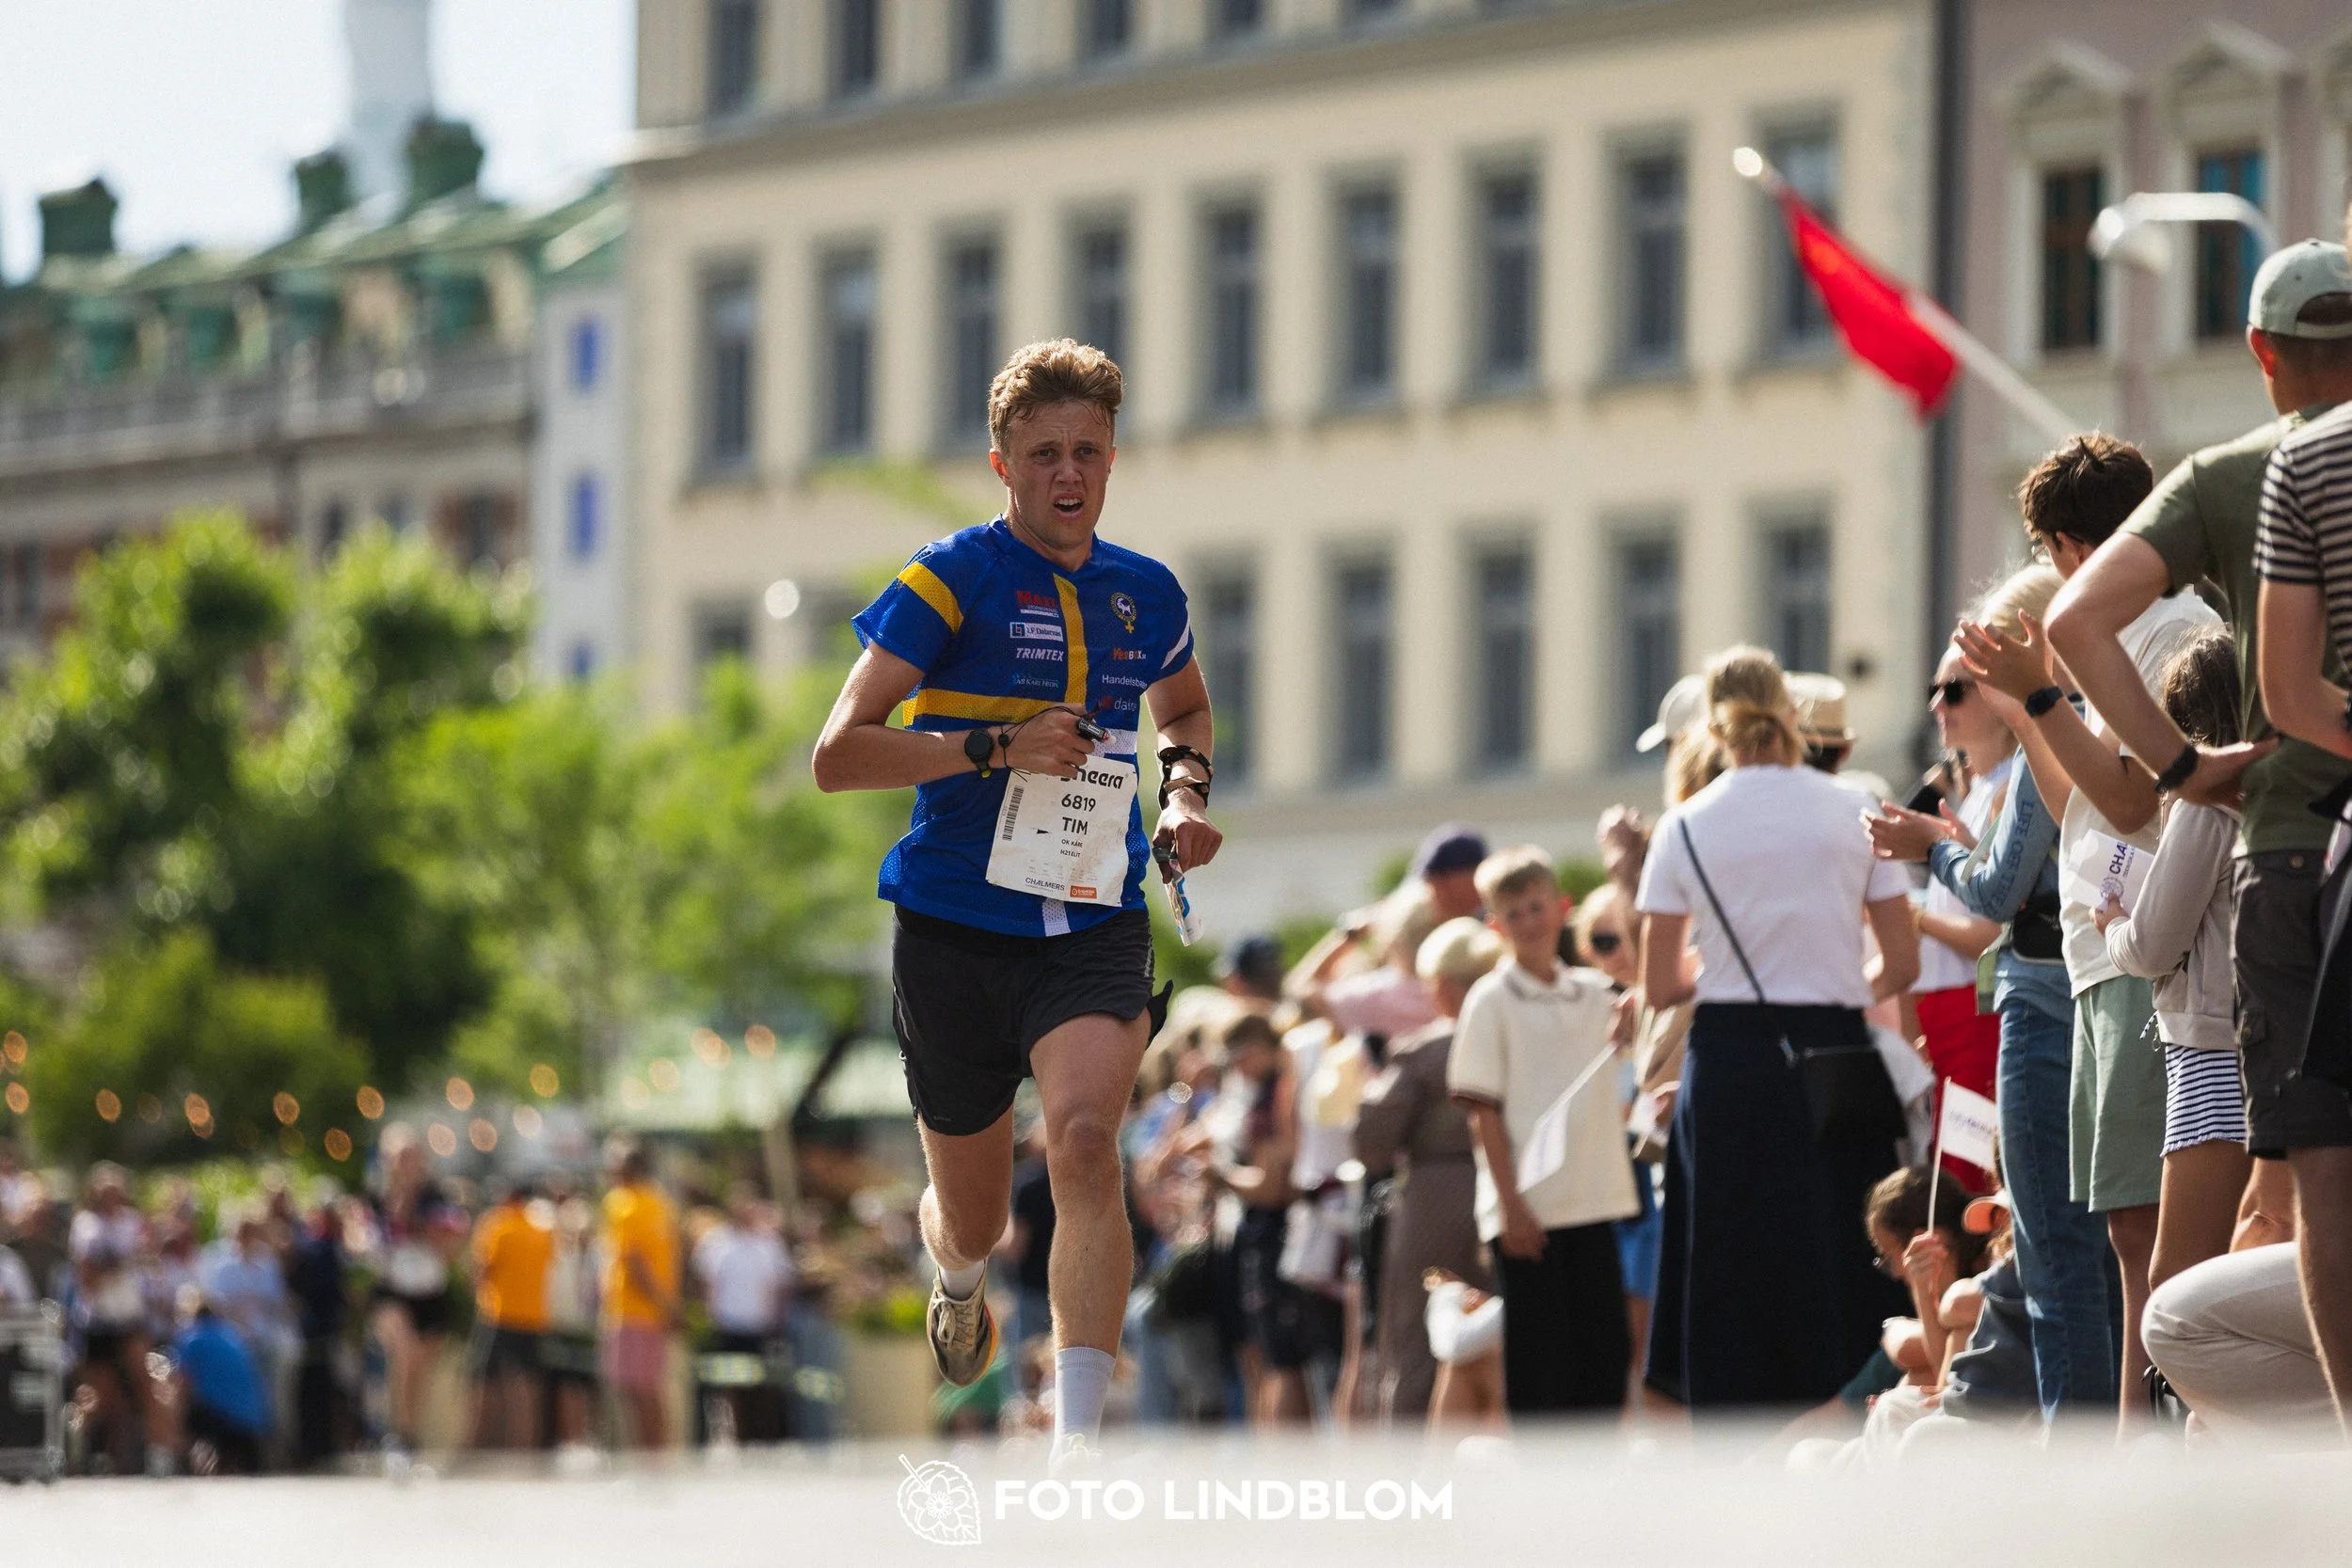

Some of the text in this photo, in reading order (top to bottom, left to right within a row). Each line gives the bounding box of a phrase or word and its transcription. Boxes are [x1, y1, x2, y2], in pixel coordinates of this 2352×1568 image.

[1016, 647, 1064, 662] TRIMTEX
[1061, 793, 1096, 812] 6819
[1062, 816, 1089, 835] TIM
[2015, 800, 2034, 837] LIFE
[1025, 877, 1065, 892] CHALMERS
